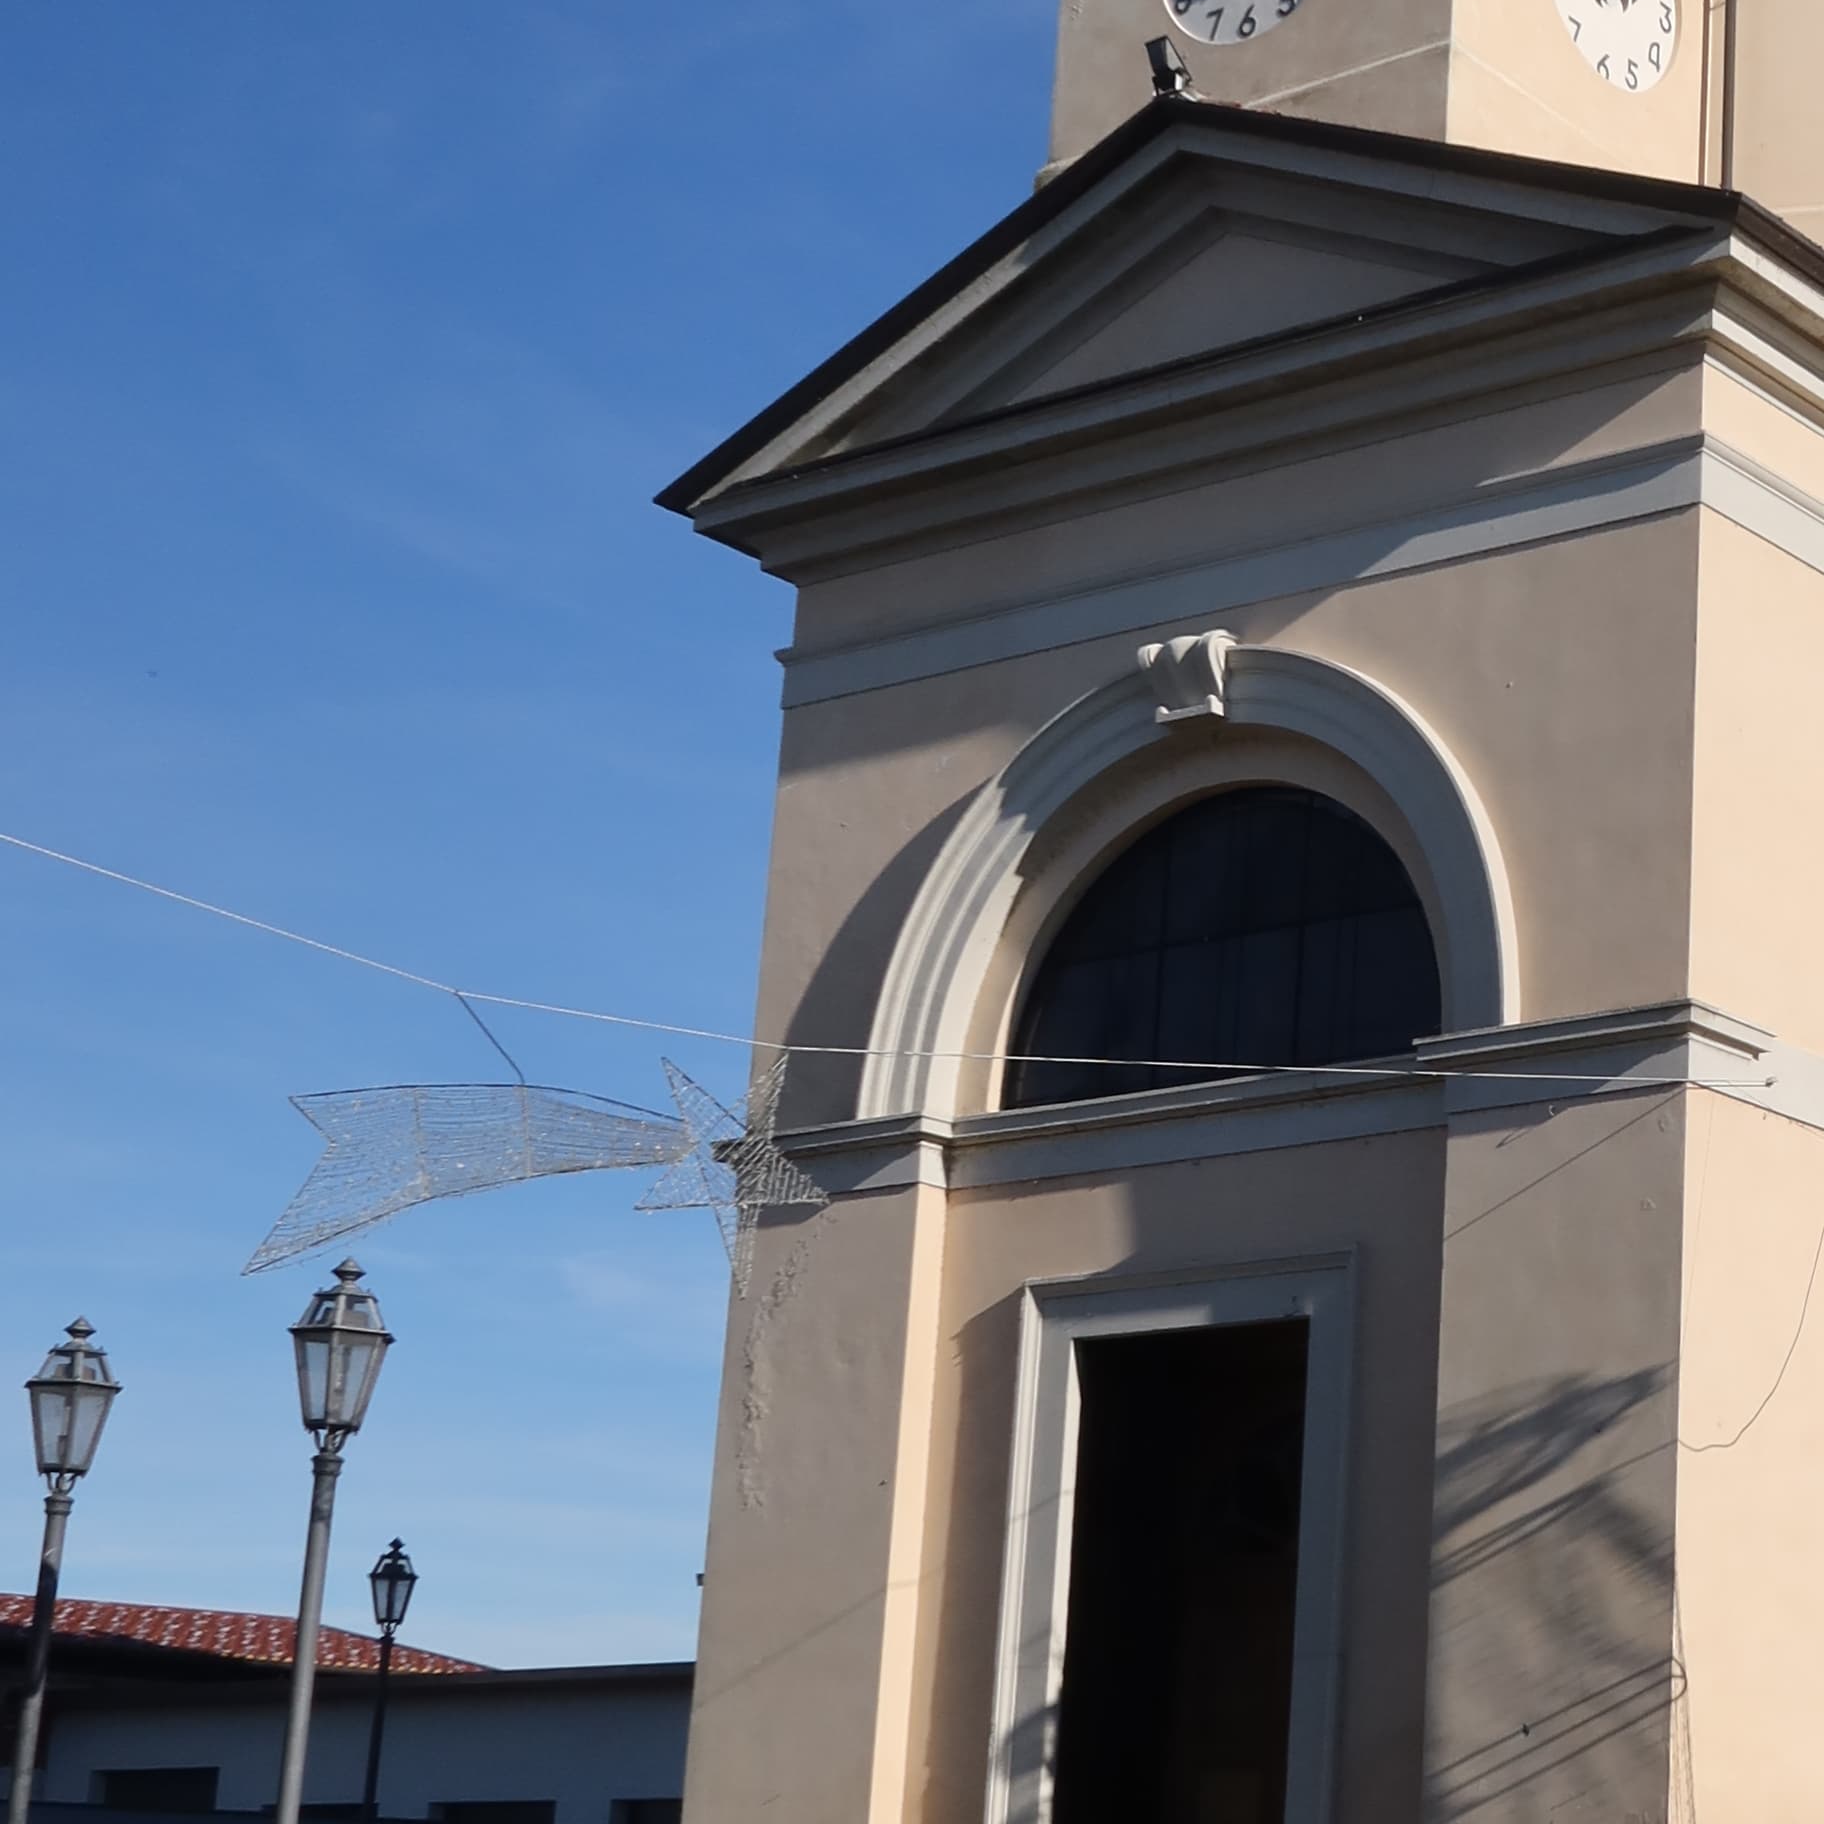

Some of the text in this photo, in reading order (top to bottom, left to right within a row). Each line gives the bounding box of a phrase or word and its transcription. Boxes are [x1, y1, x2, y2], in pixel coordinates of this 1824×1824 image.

[1206, 7, 1224, 41] 7
[1237, 4, 1257, 38] 6
[1568, 16, 1582, 42] 7
[1659, 0, 1673, 34] 3
[1624, 58, 1638, 90] 5
[1648, 42, 1660, 73] 4
